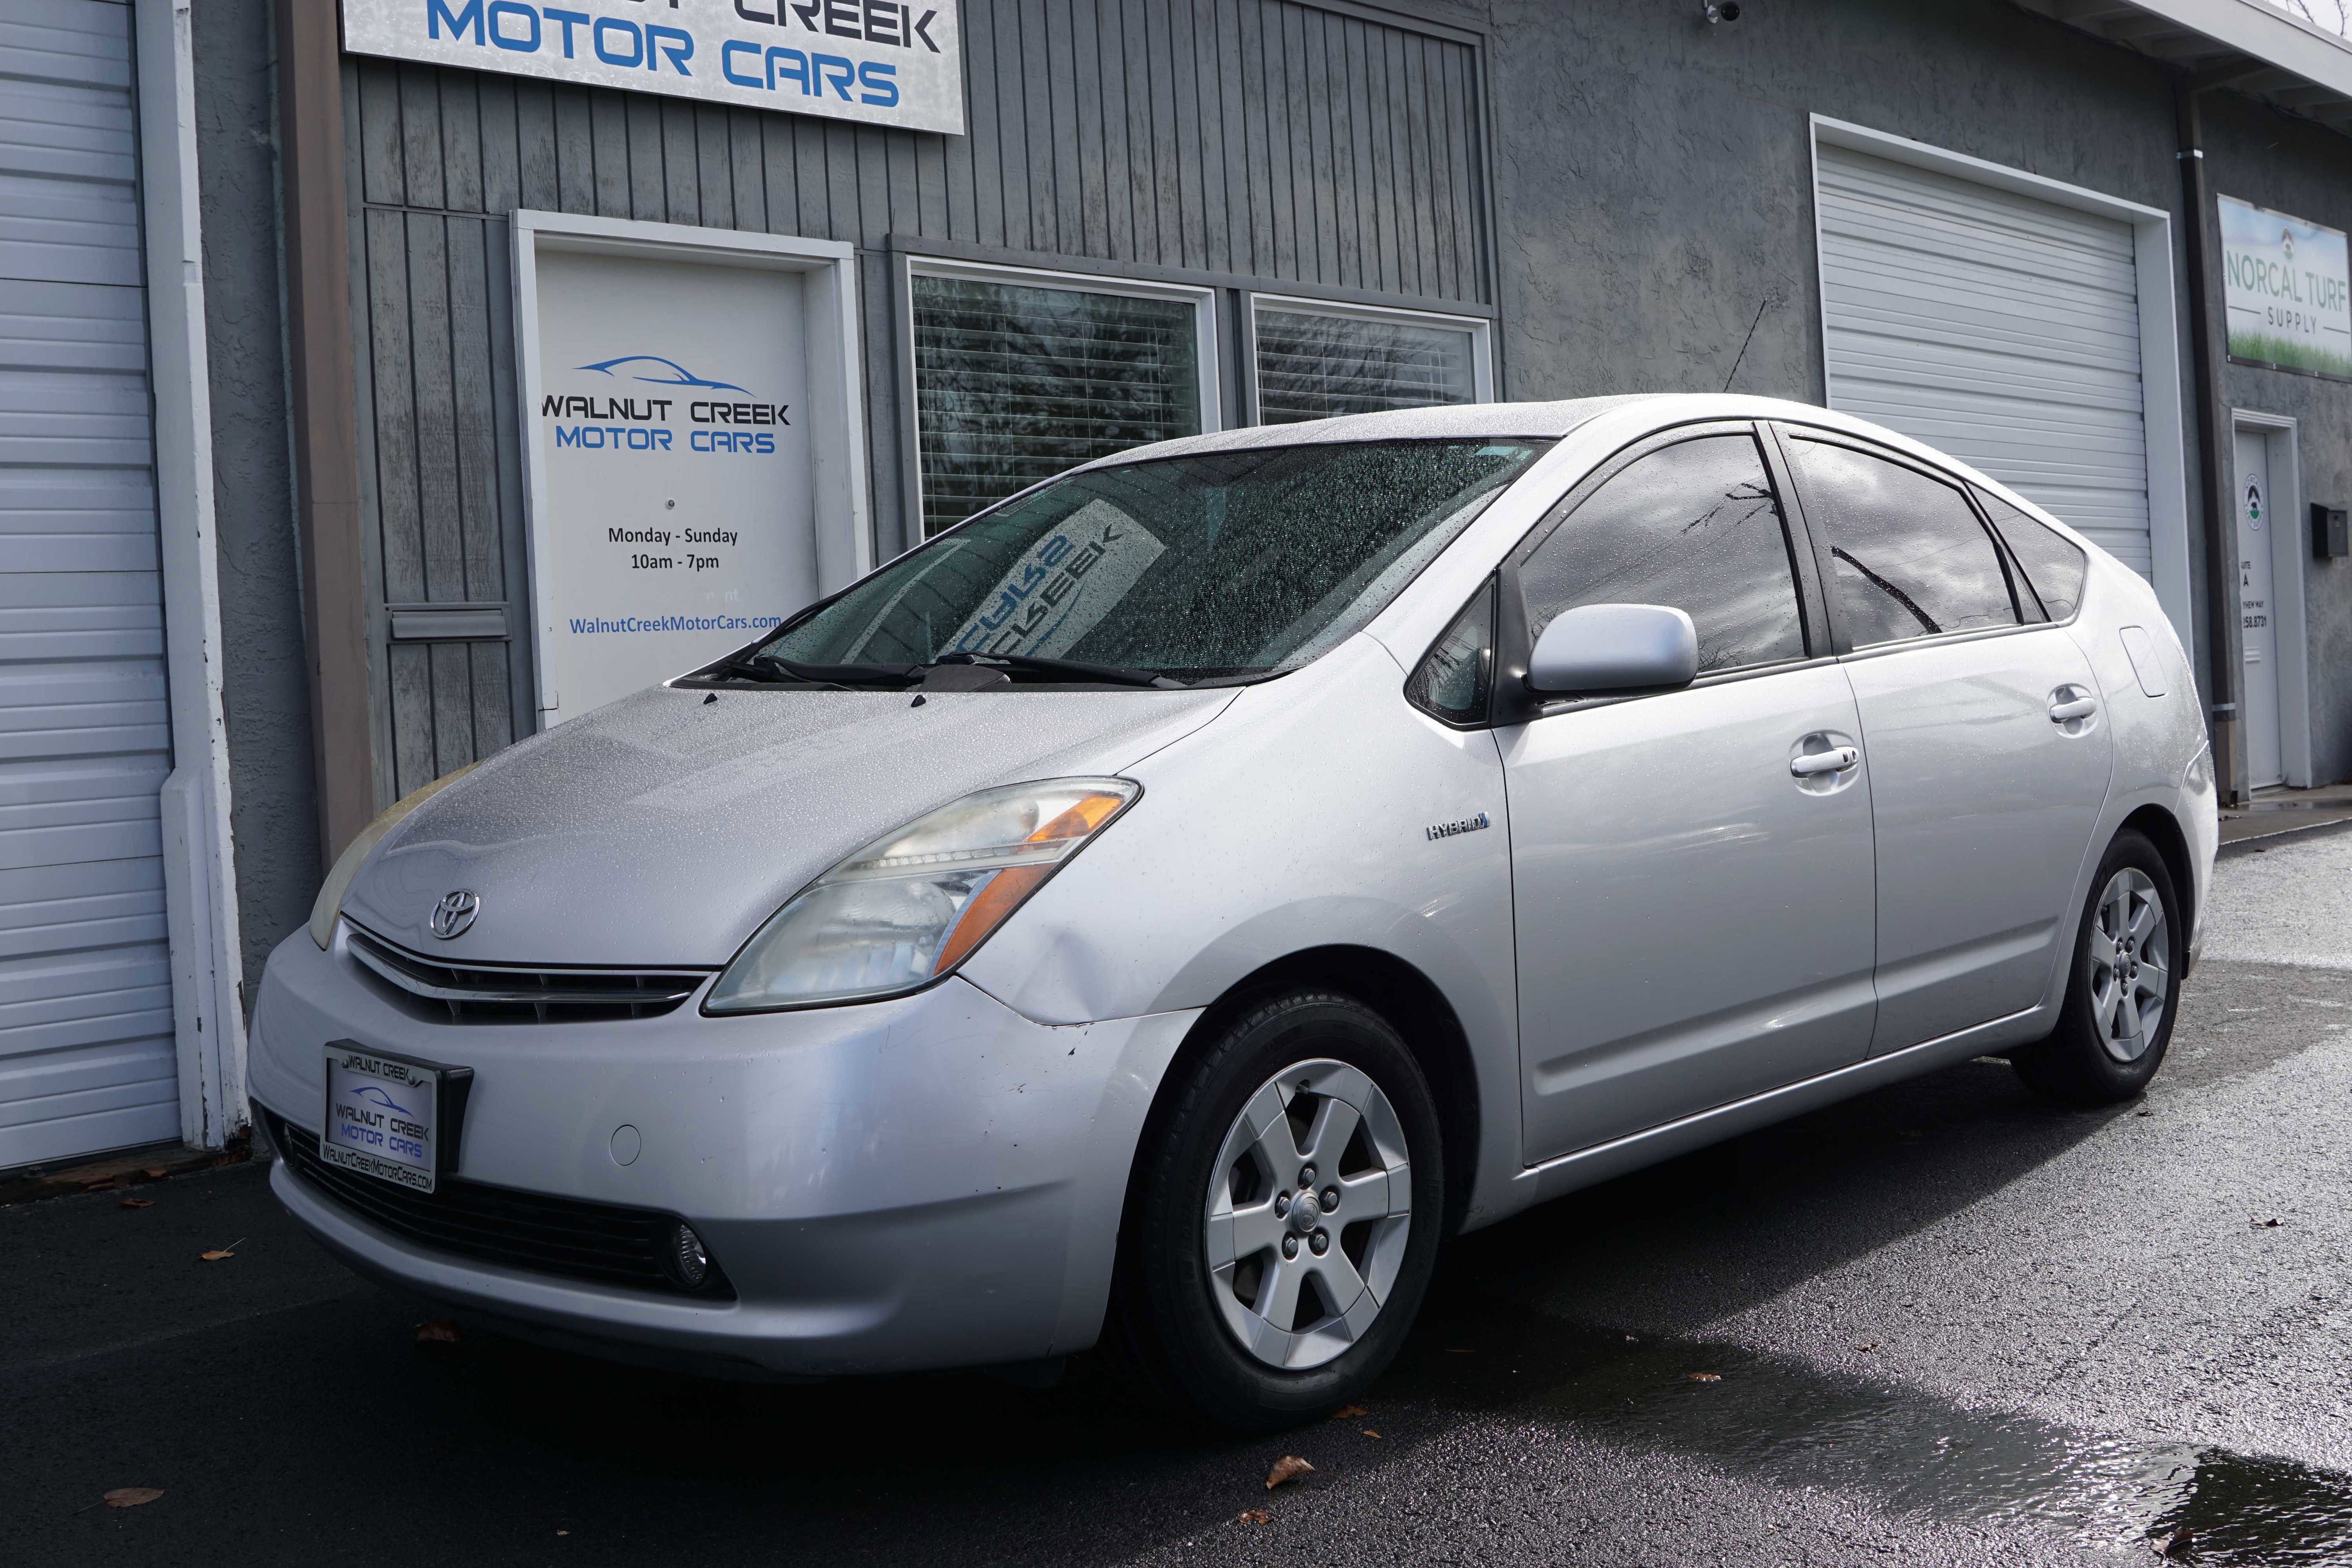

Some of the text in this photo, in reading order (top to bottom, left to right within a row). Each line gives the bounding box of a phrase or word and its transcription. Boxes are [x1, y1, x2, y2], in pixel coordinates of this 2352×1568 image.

[427, 0, 899, 107] MOTOR CARS
[2227, 250, 2346, 312] NORCAL TURF
[2268, 306, 2316, 334] SUPPLY
[542, 395, 791, 425] WALNUT CREEK
[556, 425, 775, 454] MOTOR CARS
[609, 527, 671, 546] Monday
[685, 528, 738, 546] Sunday
[632, 554, 673, 569] 10am
[687, 554, 719, 572] 7pm
[2243, 572, 2249, 587] A
[570, 615, 781, 633] WalnutCreekMotorCars.com
[1427, 816, 1482, 840] HYBRID
[349, 1055, 409, 1081] WALNUT CREEK
[336, 1103, 430, 1142] WALNUT CREEK
[341, 1123, 422, 1158] MOTOR CARS
